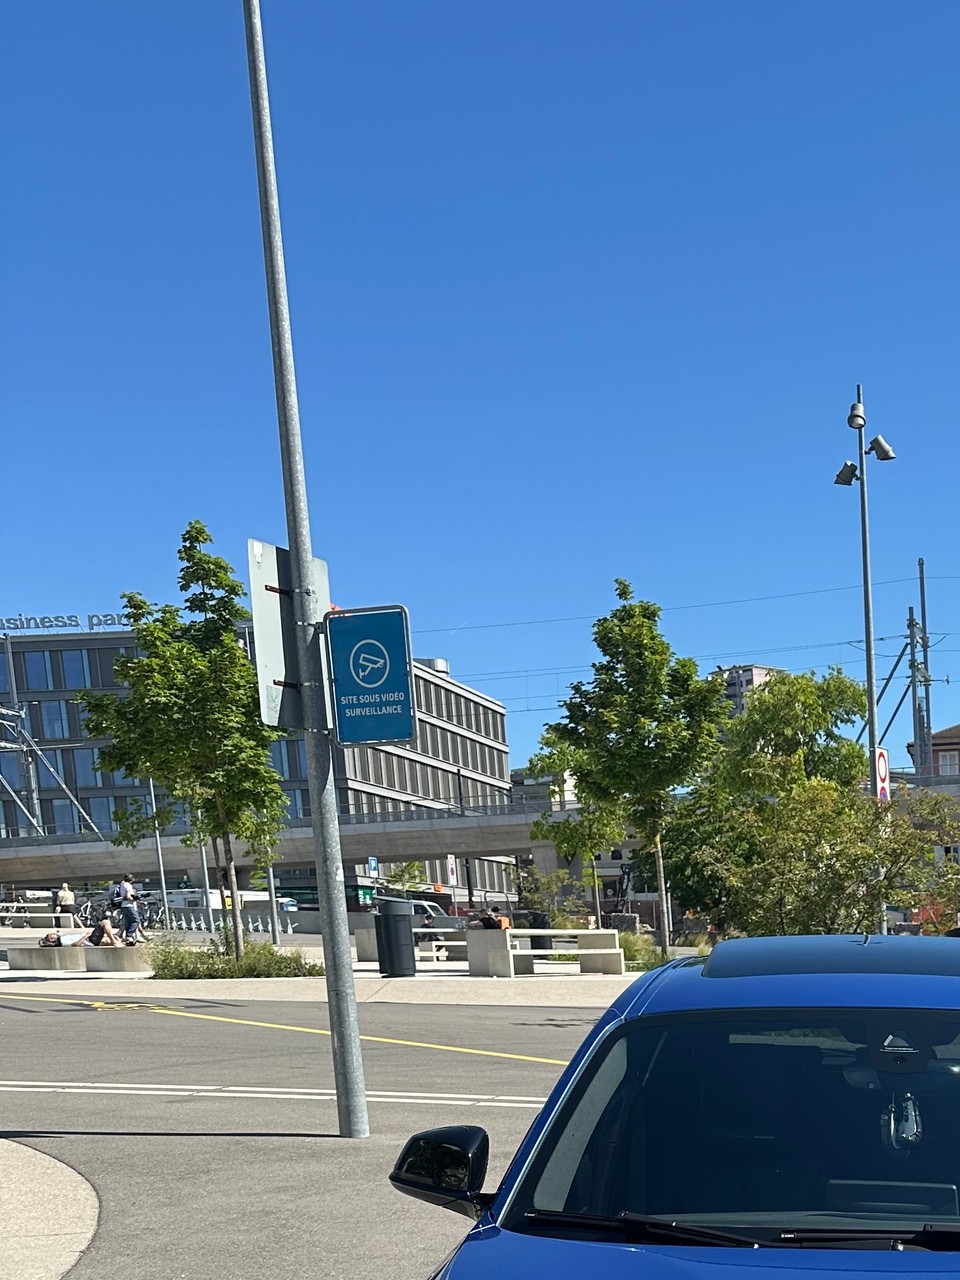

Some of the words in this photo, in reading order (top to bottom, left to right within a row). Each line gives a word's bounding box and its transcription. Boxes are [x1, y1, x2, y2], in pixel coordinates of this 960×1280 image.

[87, 612, 131, 631] par
[340, 695, 358, 705] SITE
[359, 693, 380, 704] SOUS
[381, 690, 405, 702] VIDÉO
[345, 704, 402, 717] SURVEILLANCE
